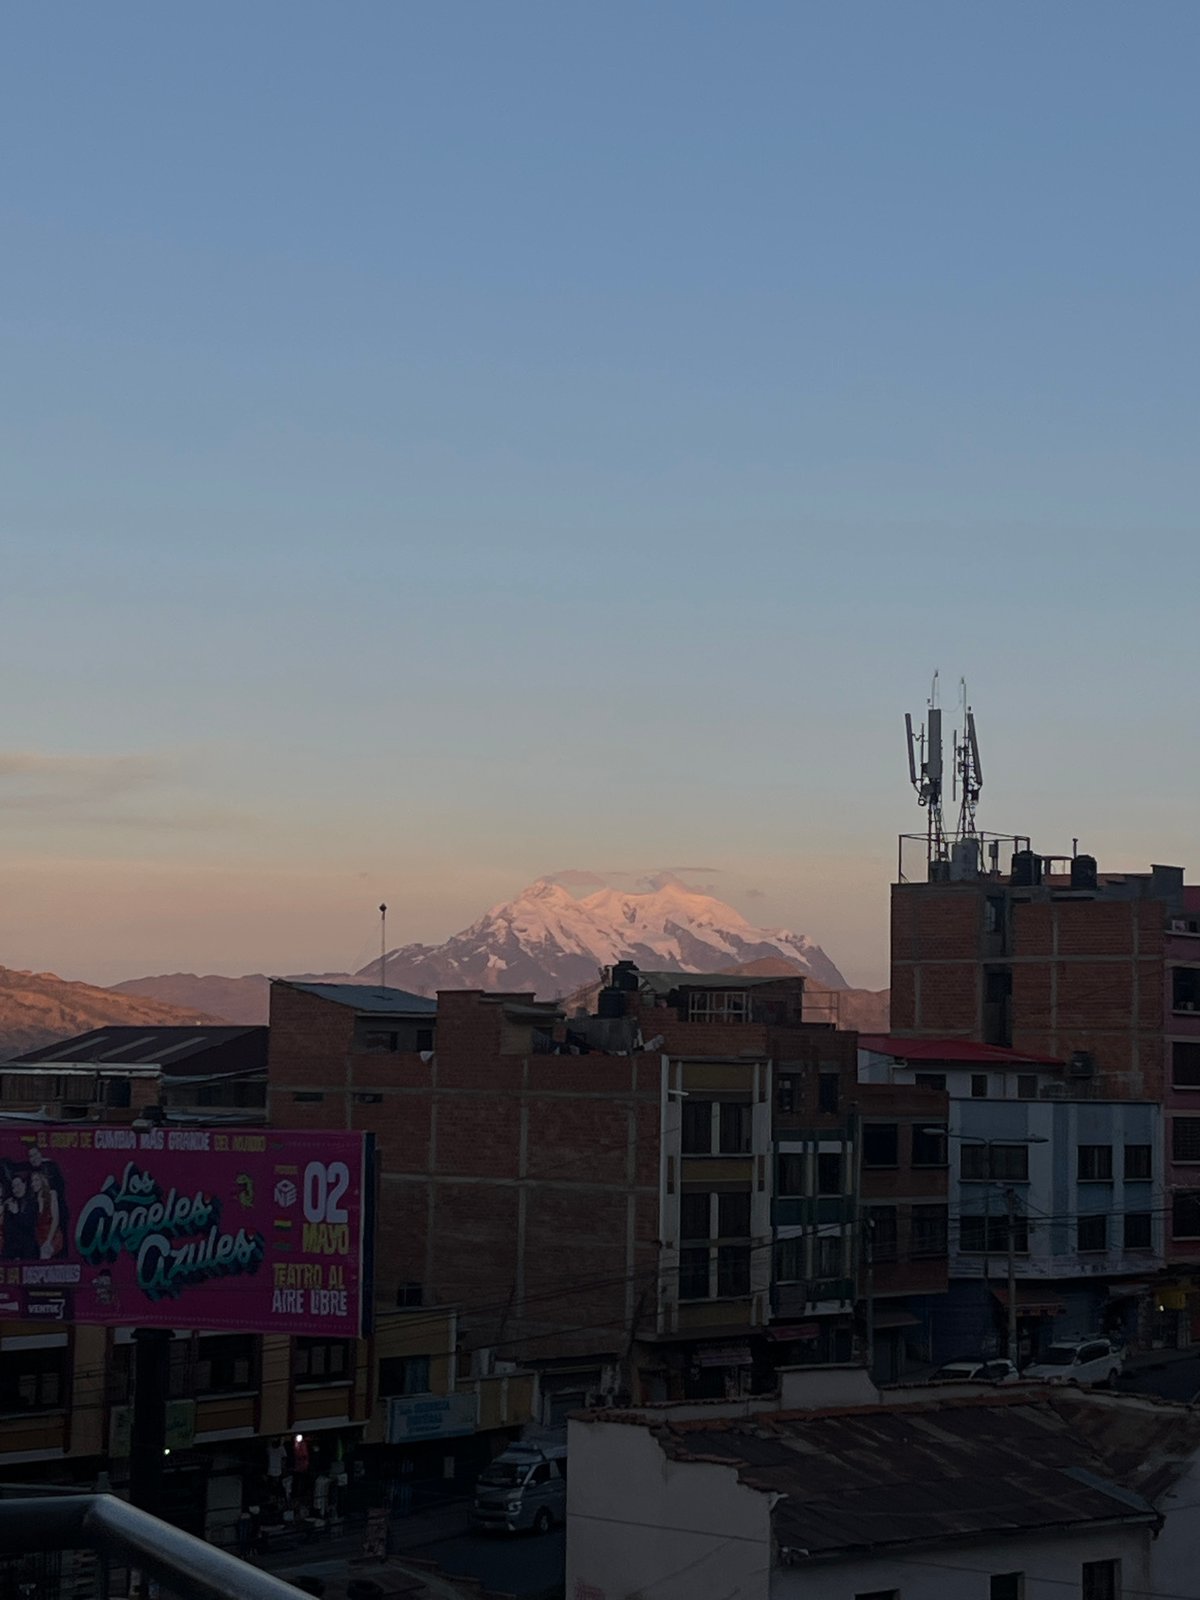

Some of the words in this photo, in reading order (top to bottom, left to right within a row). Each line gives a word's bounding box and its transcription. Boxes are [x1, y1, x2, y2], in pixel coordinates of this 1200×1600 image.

[167, 1131, 211, 1151] GRANDE
[114, 1160, 158, 1204] Los
[303, 1160, 350, 1224] 02
[302, 1223, 350, 1255] MAYO
[136, 1224, 257, 1290] Azules
[272, 1262, 323, 1289] TEATRO
[328, 1265, 346, 1289] AL
[271, 1289, 305, 1314] AIRE
[310, 1290, 348, 1316] LIBRE
